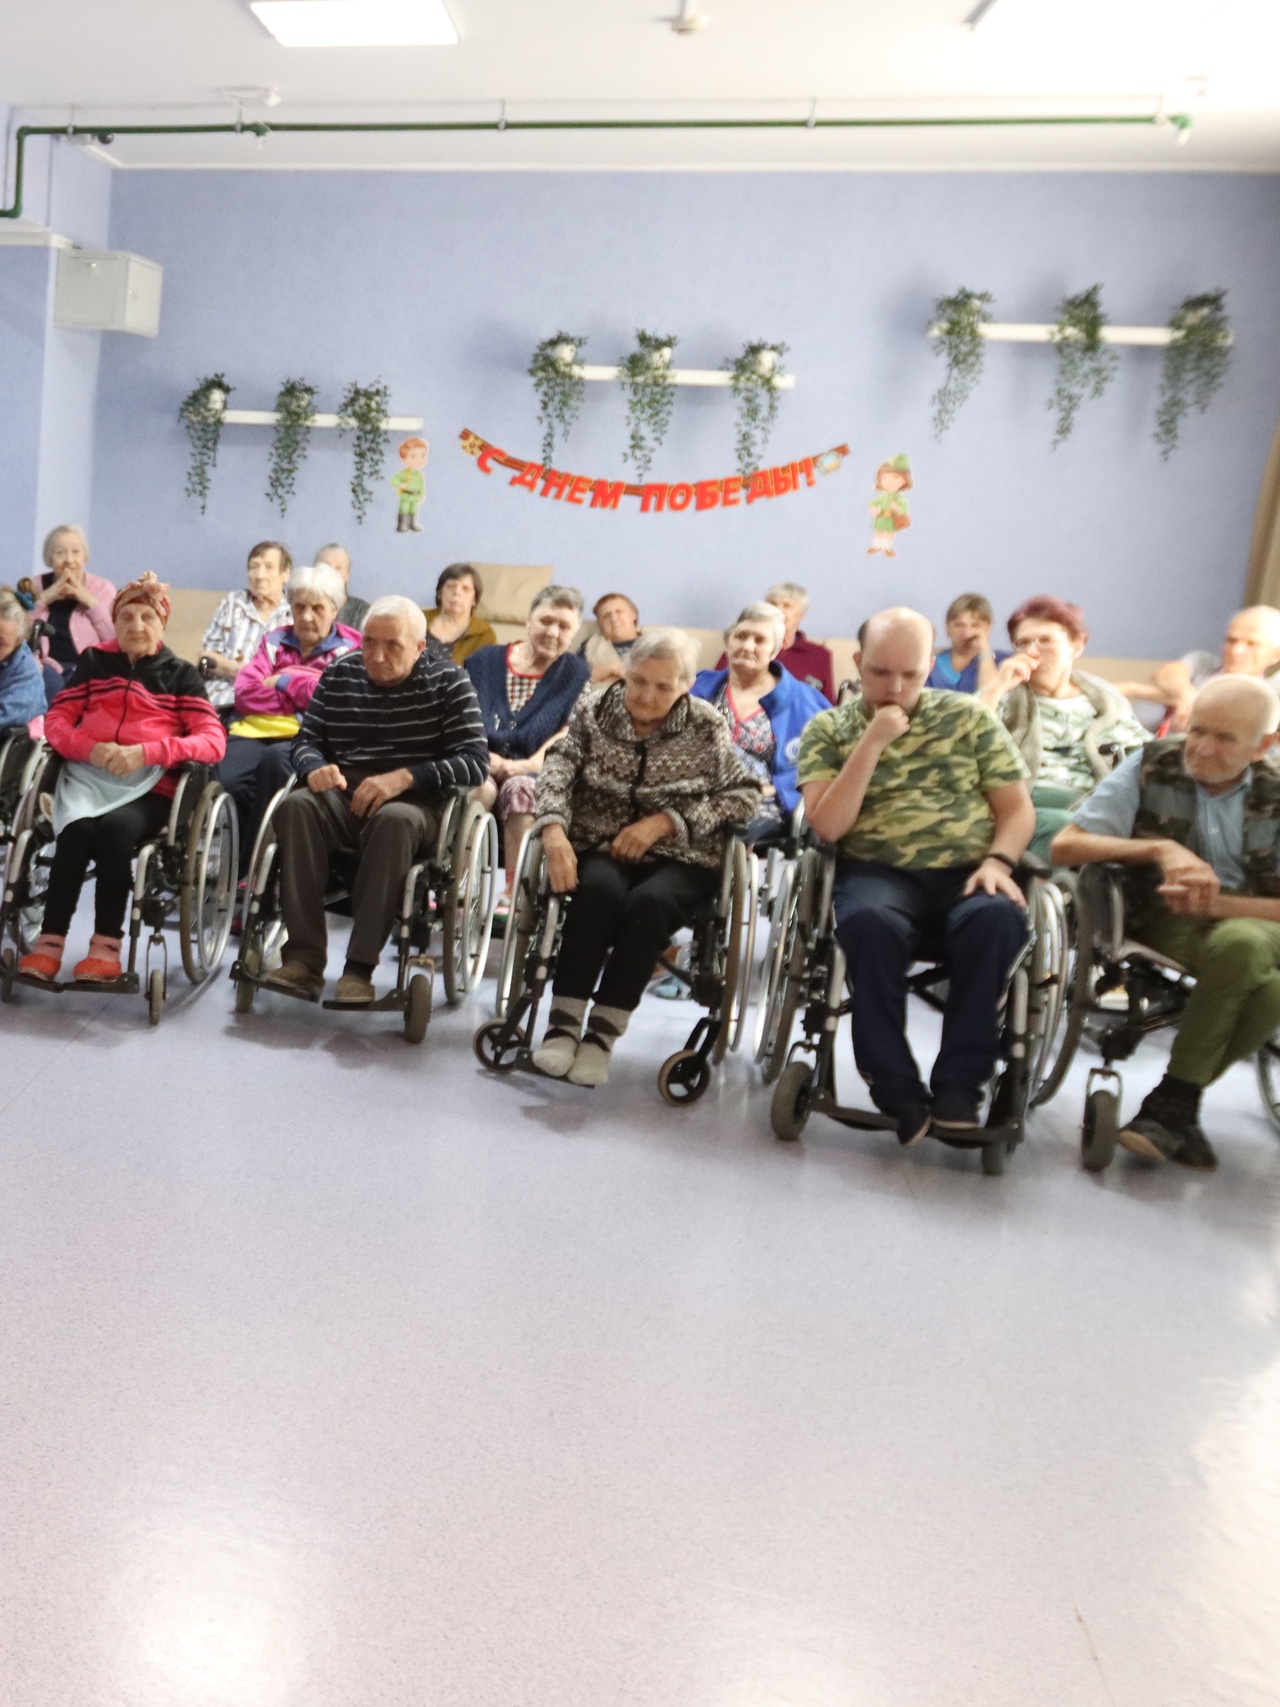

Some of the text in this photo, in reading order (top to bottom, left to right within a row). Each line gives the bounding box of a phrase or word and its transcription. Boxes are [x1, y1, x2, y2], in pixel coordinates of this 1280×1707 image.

[476, 447, 818, 513] С ДНЕМ ПОБЕДЫ!
